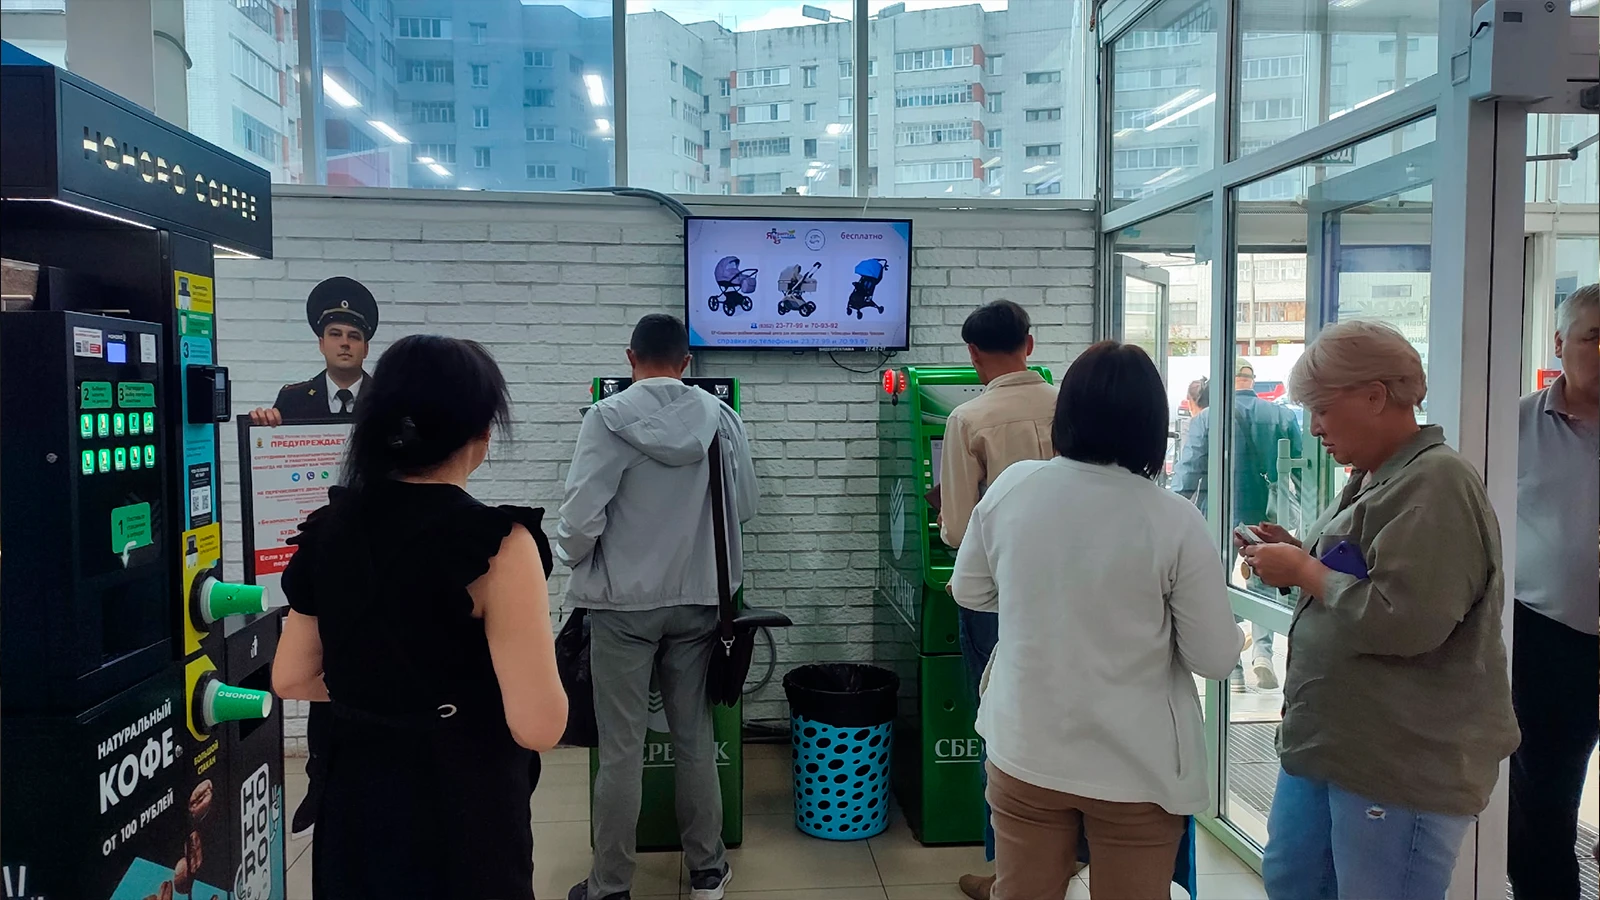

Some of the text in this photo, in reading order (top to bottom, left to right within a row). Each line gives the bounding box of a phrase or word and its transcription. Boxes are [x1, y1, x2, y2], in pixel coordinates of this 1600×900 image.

[195, 174, 257, 221] COFFEE
[841, 231, 883, 240] бесплатно
[184, 342, 189, 358] 3
[84, 388, 89, 401] 2
[119, 388, 124, 401] 3
[270, 438, 346, 448] ПРЕДУПРЕЖДАЕТ
[118, 519, 123, 536] 1
[260, 554, 278, 562] Если
[98, 697, 172, 760] НАТУРАЛЬНЫЙ
[100, 727, 174, 815] КОФЕ
[198, 755, 216, 775] СТАКАН
[102, 787, 173, 856] ОТ 100 РУБЛЕЙ
